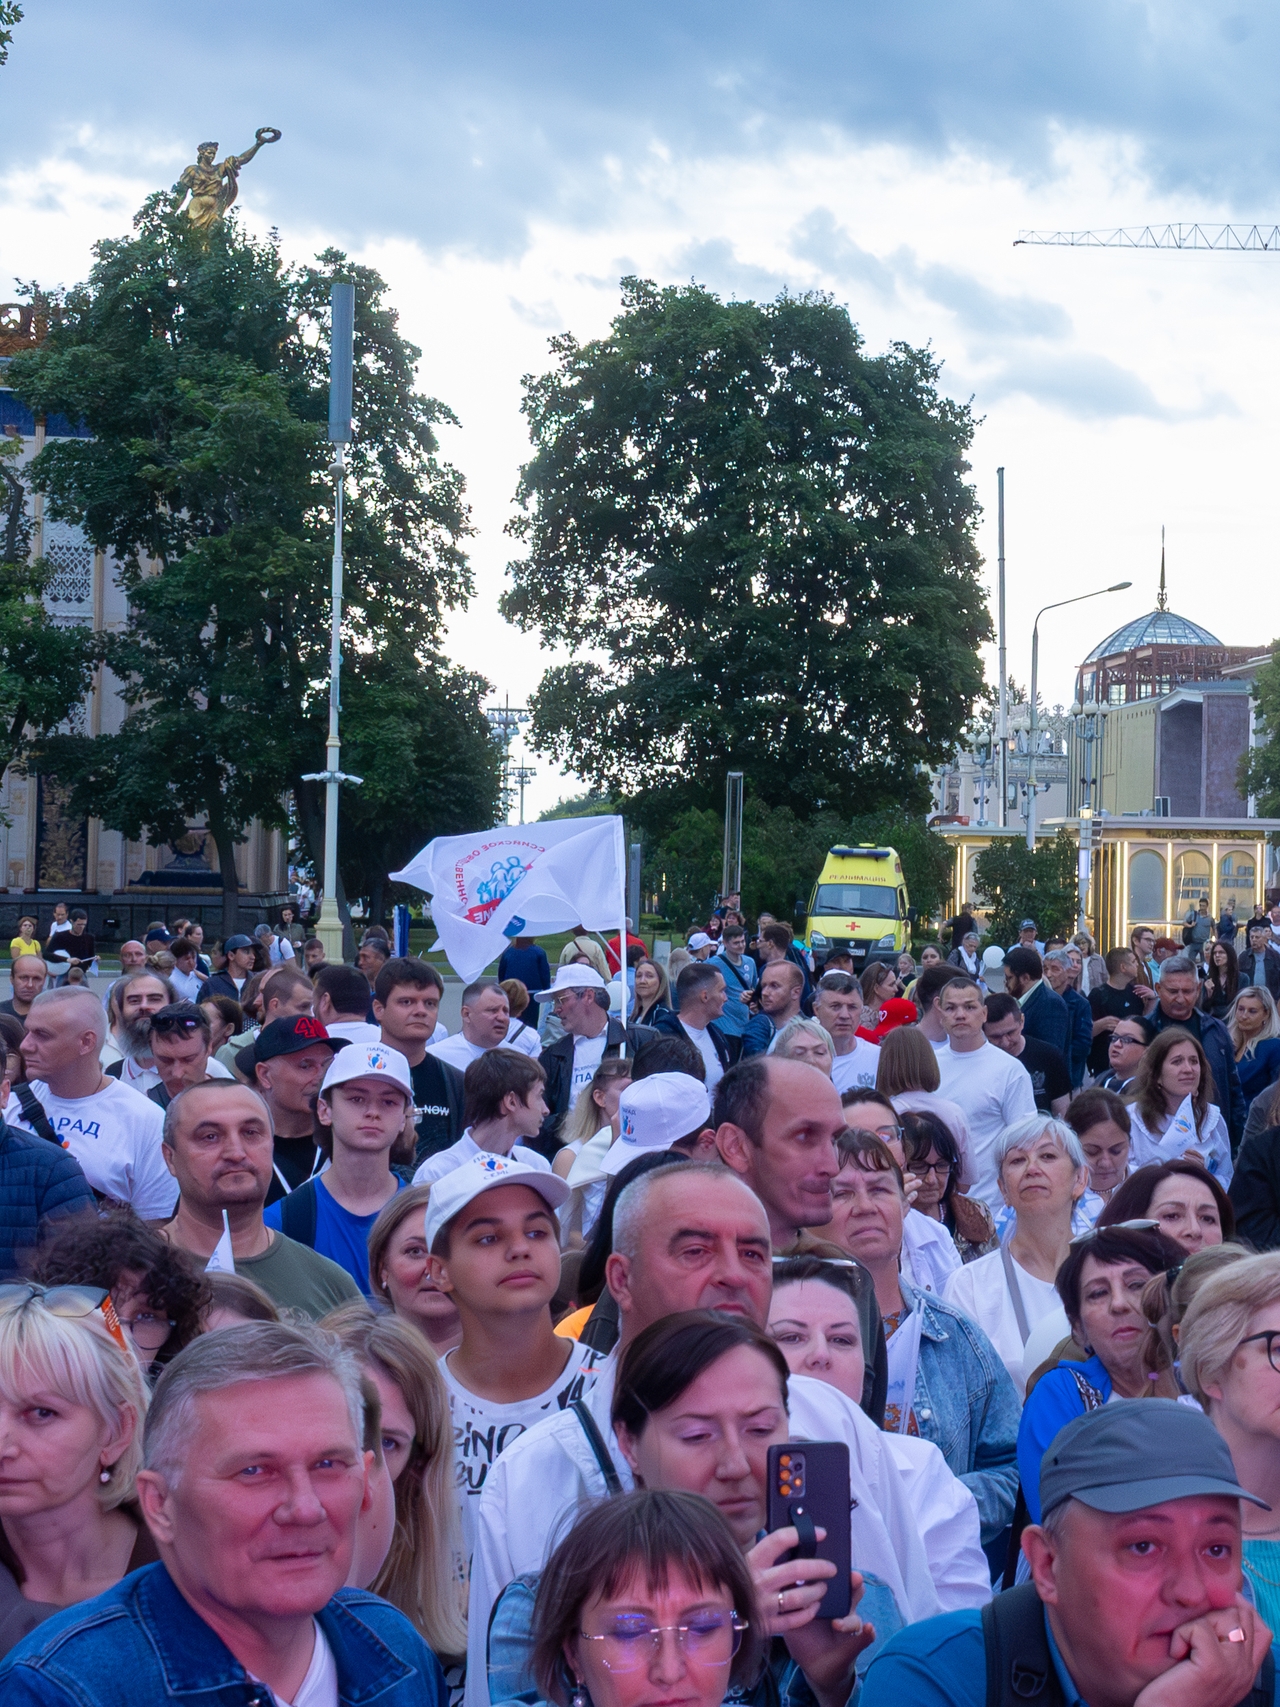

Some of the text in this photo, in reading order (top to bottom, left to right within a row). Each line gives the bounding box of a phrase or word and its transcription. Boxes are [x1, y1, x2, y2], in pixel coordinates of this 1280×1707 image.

[829, 874, 887, 883] РЕАНИМАЦИЯ
[575, 1072, 593, 1084] ПА
[424, 1104, 450, 1117] NOW
[29, 1116, 101, 1140] АРАД
